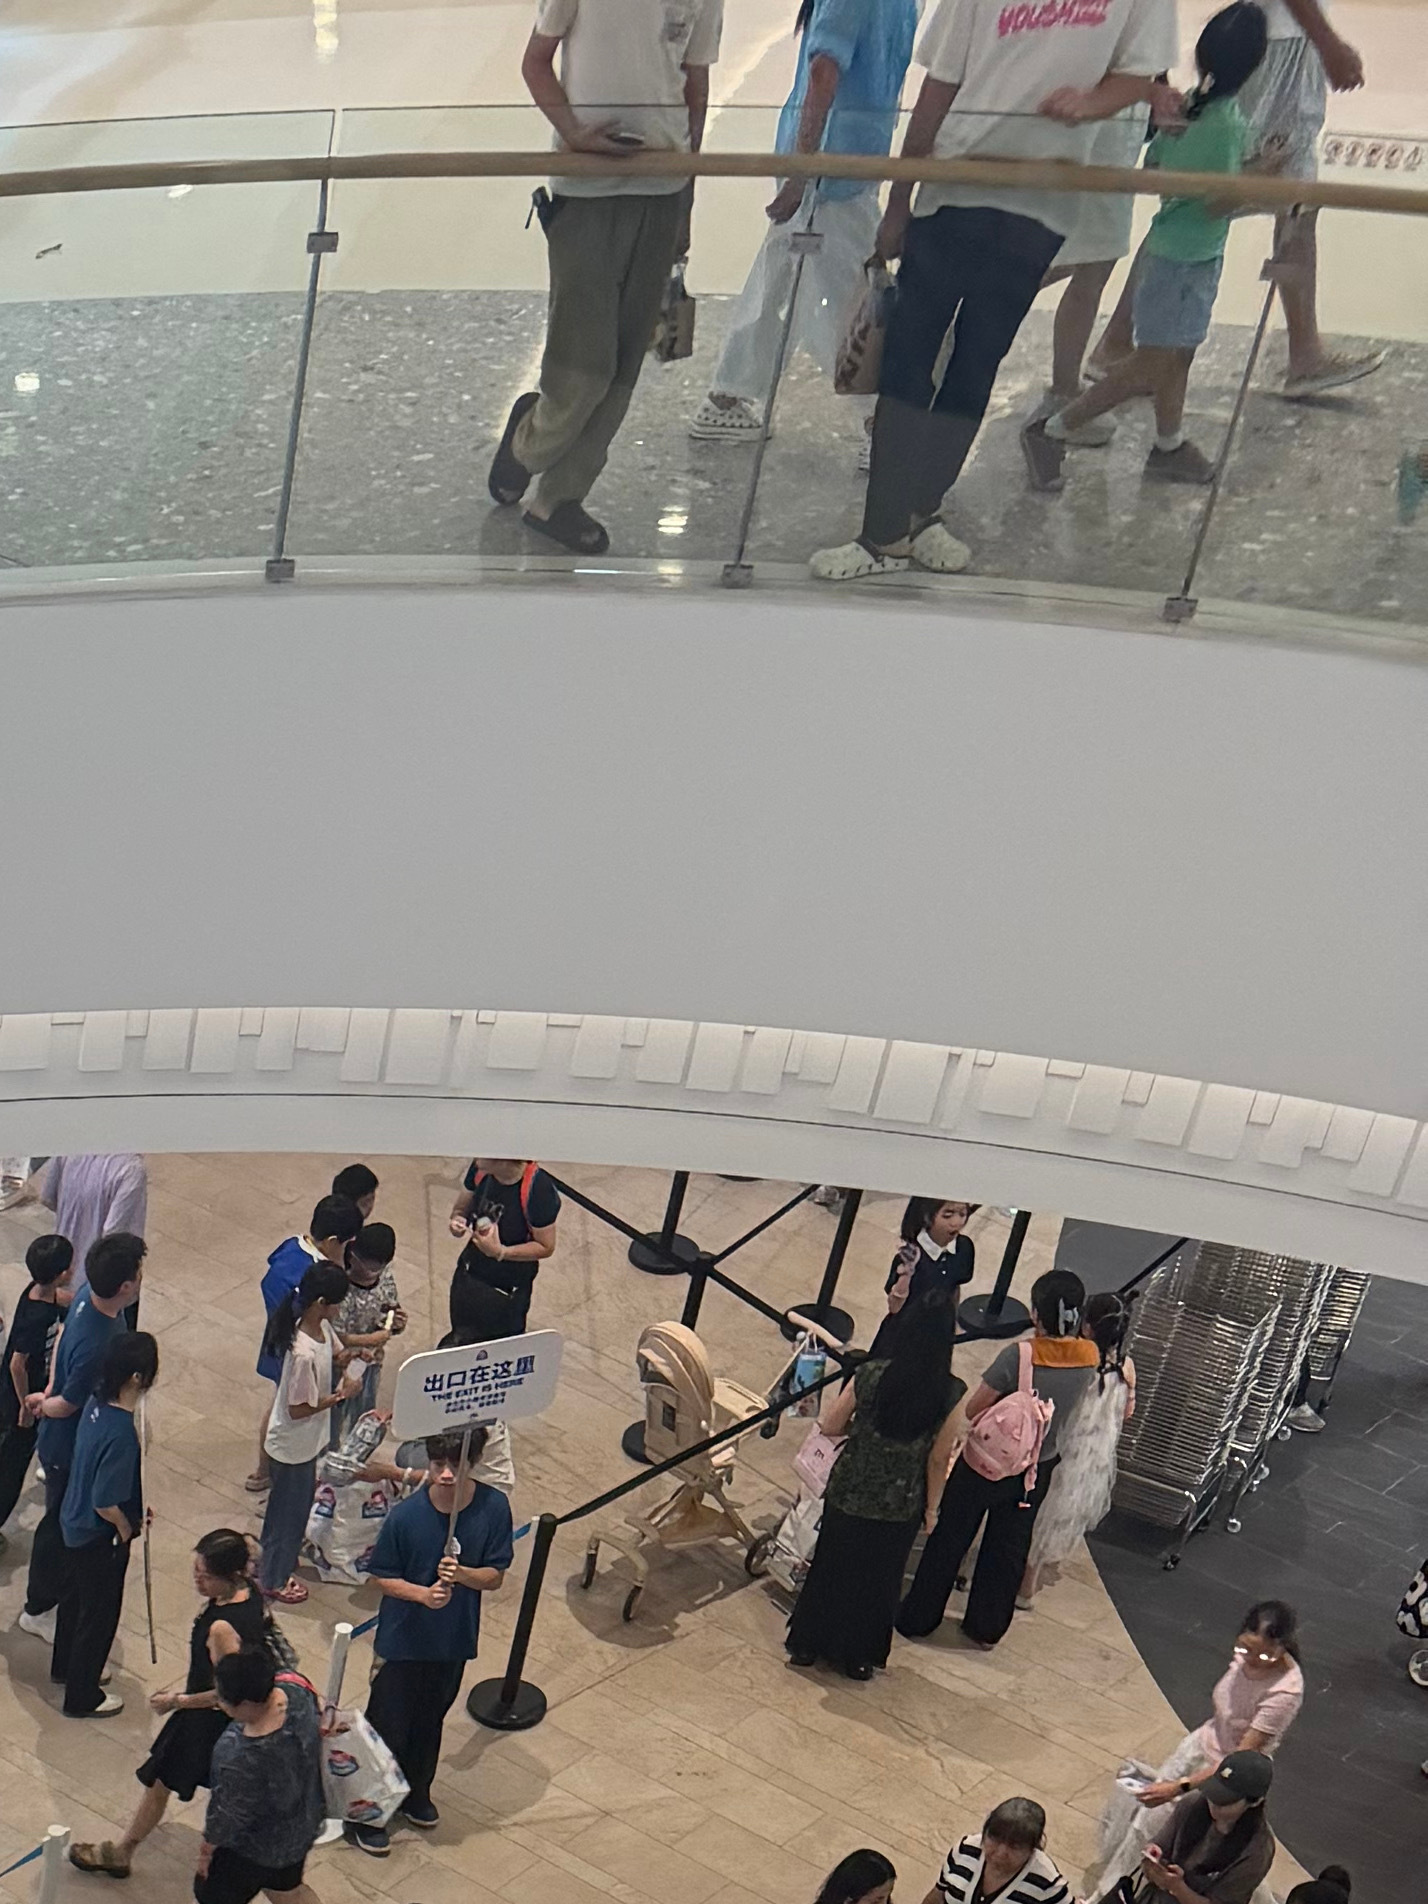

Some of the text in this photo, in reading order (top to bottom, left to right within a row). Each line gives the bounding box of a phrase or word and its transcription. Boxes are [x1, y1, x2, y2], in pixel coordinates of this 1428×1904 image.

[424, 1355, 535, 1392] 出口在这里
